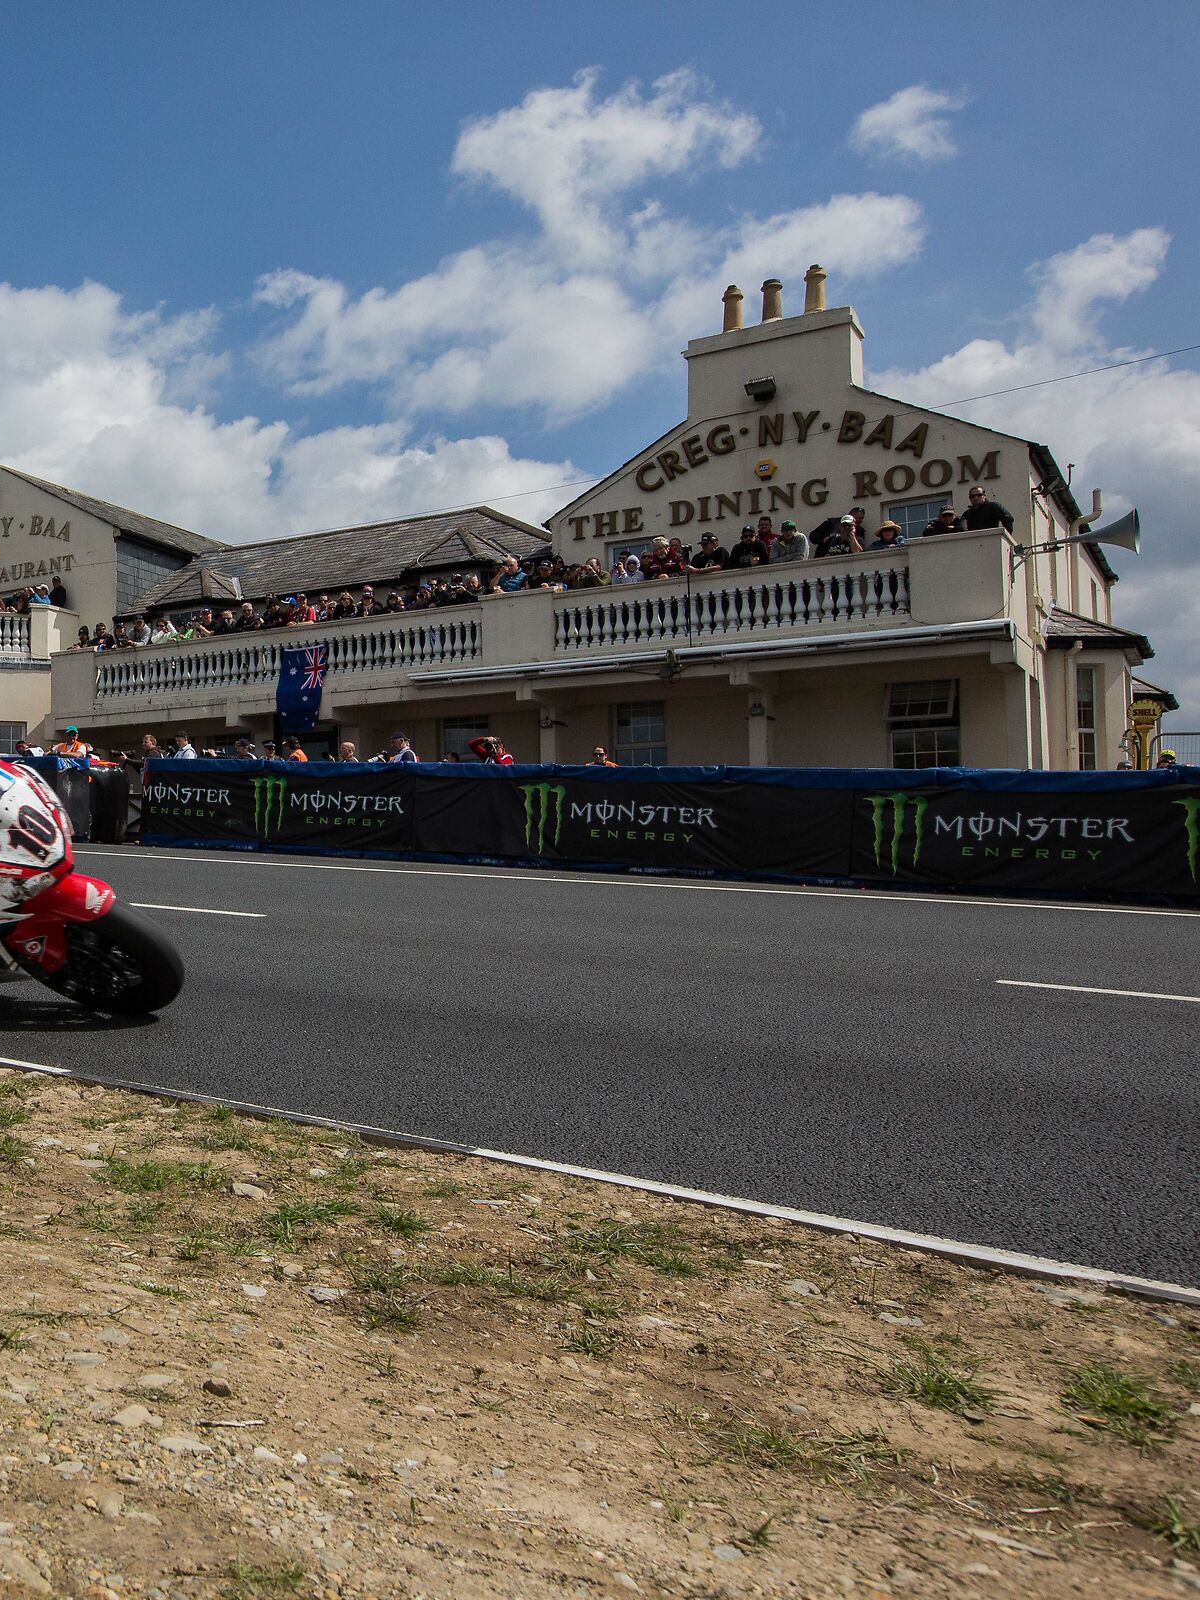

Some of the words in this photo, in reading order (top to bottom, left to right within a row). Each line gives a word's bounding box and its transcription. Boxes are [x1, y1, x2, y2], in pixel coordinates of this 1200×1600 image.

[635, 424, 736, 492] CREG
[758, 410, 820, 447] NY
[838, 410, 929, 458] BAA
[568, 506, 645, 541] THE
[668, 477, 829, 526] DINING
[852, 450, 1001, 499] ROOM
[28, 515, 70, 542] BAA
[1132, 708, 1157, 717] SHELL
[142, 782, 231, 806] MONSTER
[290, 790, 404, 814] MONSTER
[150, 807, 216, 818] ENERGY
[306, 816, 386, 828] ENERGY
[570, 799, 719, 829] MONSTER
[7, 804, 57, 863] 10
[590, 829, 695, 843] ENERGY
[934, 811, 1135, 843] MONSTER
[962, 846, 1102, 861] ENERGY
